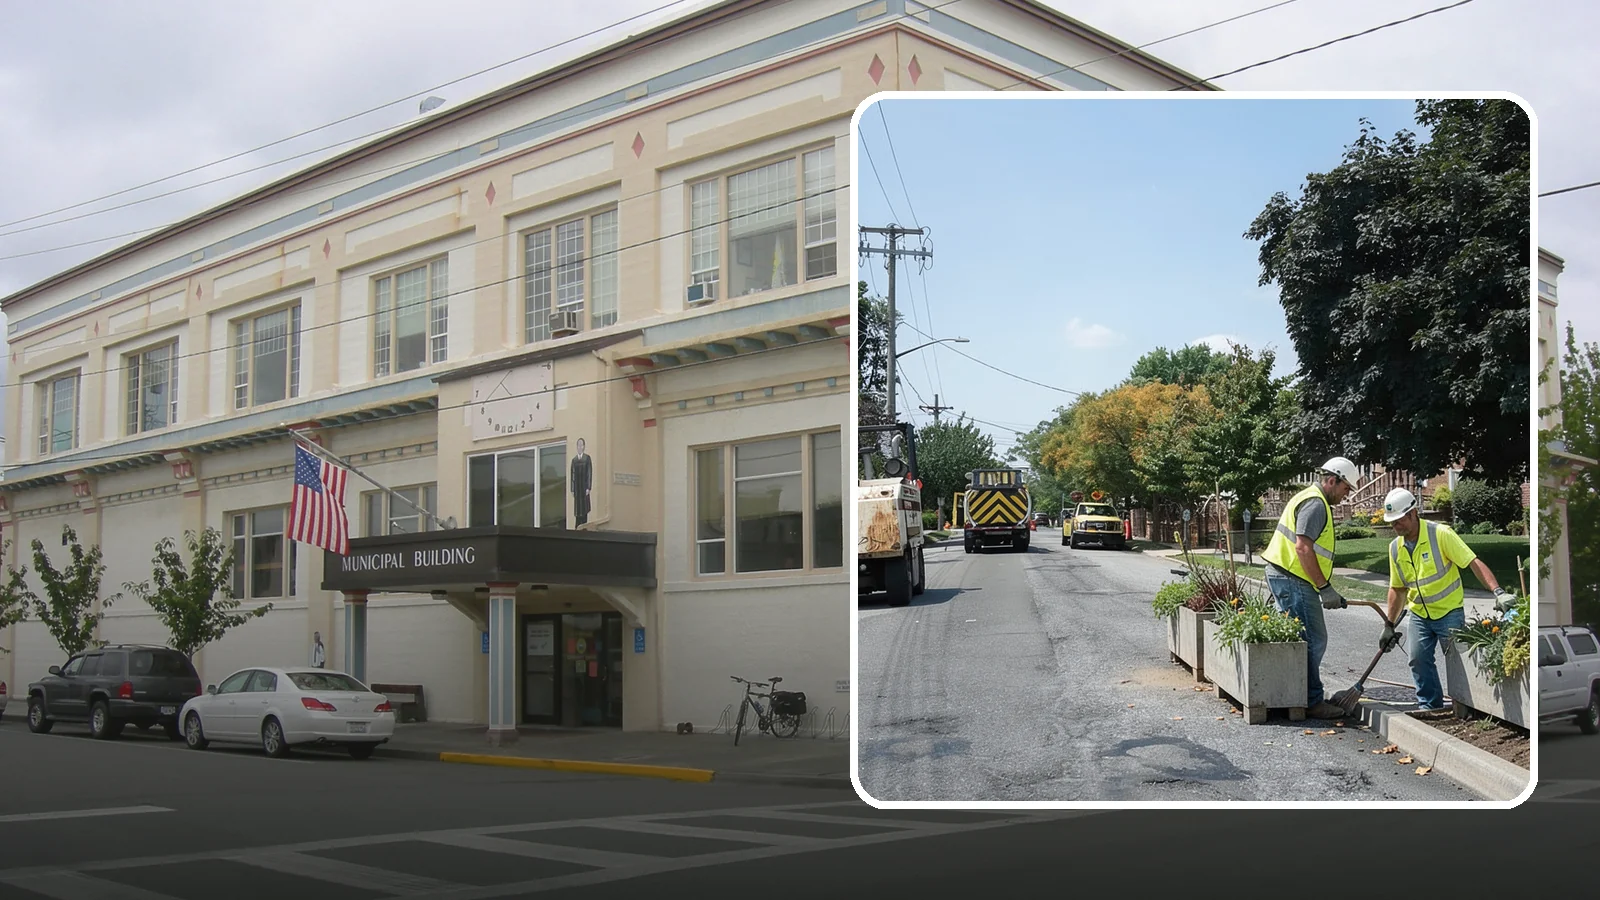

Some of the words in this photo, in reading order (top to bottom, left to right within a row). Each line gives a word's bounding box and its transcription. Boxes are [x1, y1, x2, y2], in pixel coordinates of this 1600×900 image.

[546, 363, 552, 371] 6
[475, 390, 480, 398] 7
[535, 402, 540, 410] 4
[480, 407, 485, 415] 8
[487, 417, 493, 426] 9
[528, 414, 533, 422] 3
[494, 423, 500, 431] 10
[520, 420, 526, 428] 2
[501, 425, 506, 433] 11
[507, 425, 513, 433] 12
[342, 552, 405, 572] MUNICIPAL
[414, 546, 475, 567] BUILDING
